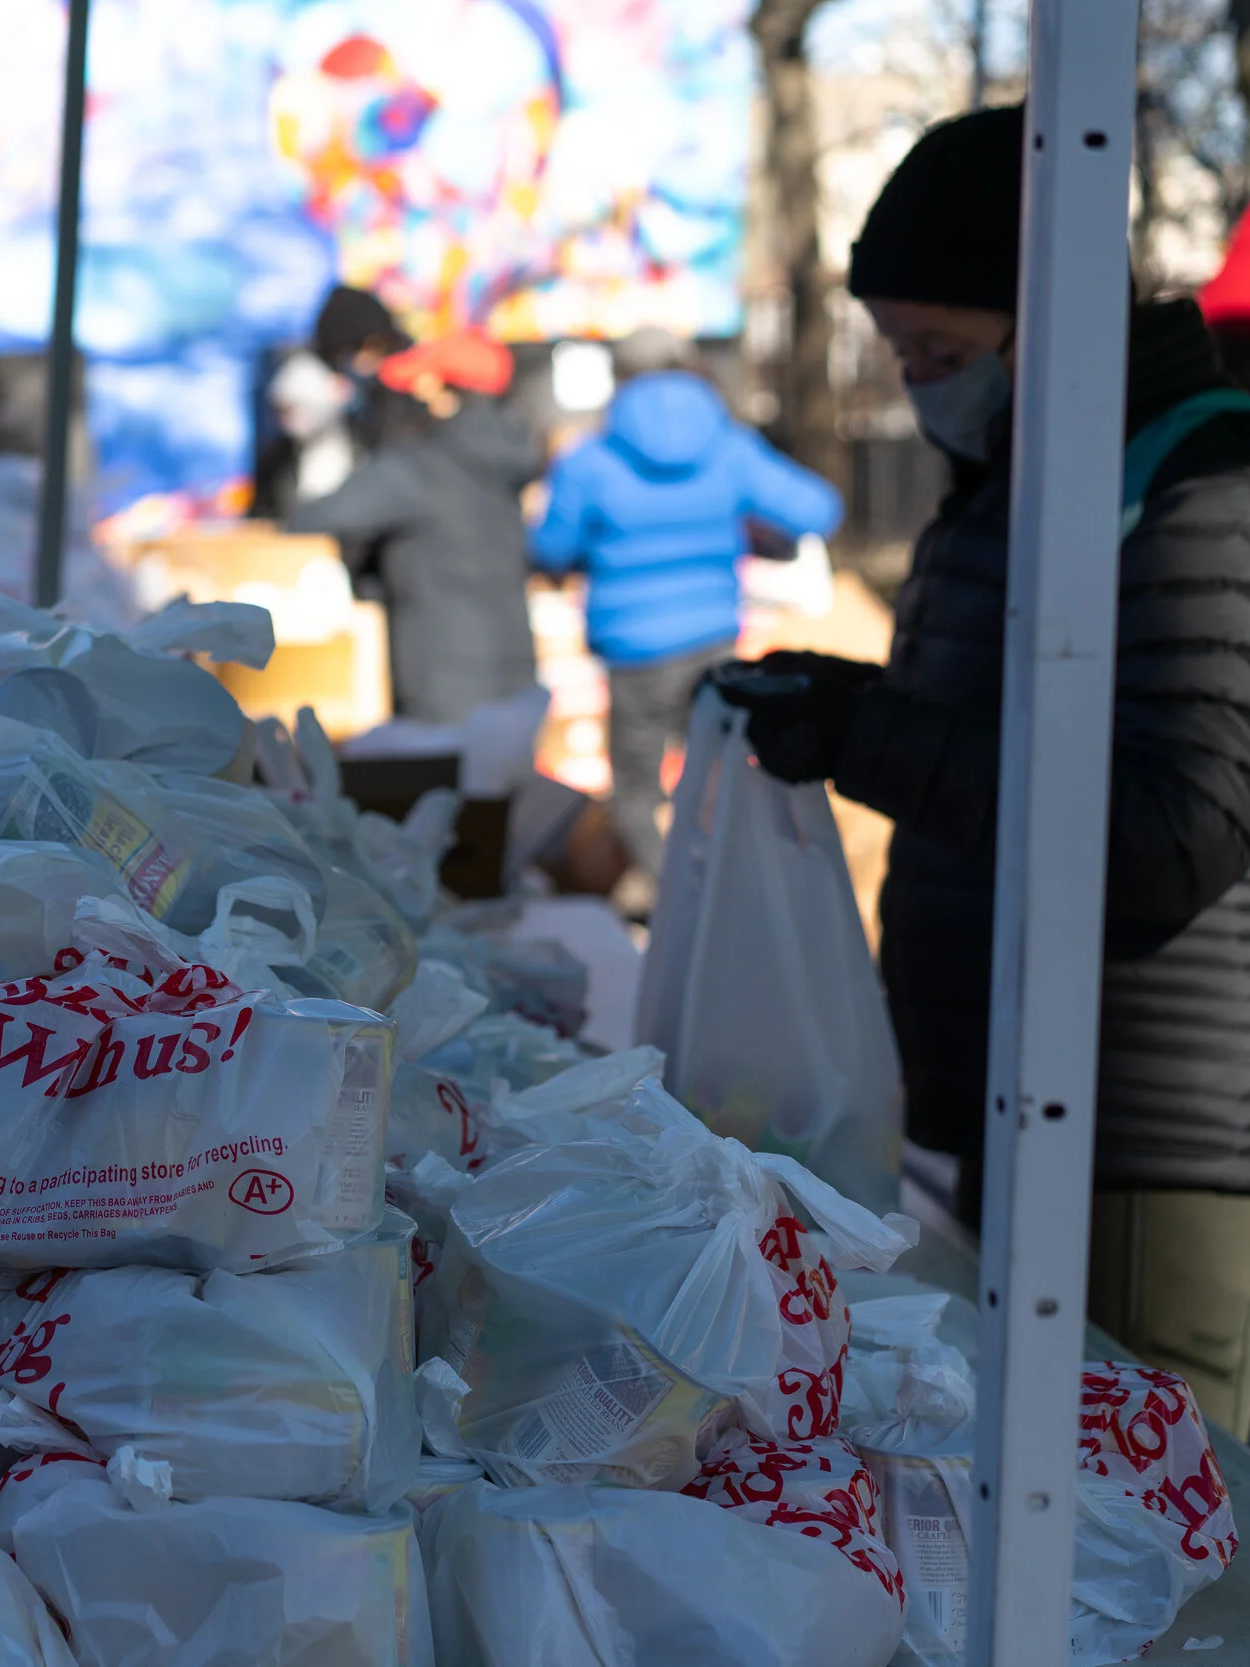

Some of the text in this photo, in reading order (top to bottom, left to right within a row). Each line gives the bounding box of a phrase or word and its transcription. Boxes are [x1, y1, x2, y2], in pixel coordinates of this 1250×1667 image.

[133, 1007, 253, 1080] us!
[10, 1176, 26, 1195] to
[28, 1180, 37, 1193] a
[40, 1164, 138, 1195] participating
[141, 1161, 185, 1181] store
[187, 1153, 203, 1173] for
[205, 1135, 288, 1164] recycling.
[0, 1208, 11, 1217] OF
[64, 1199, 86, 1208] KEEP
[88, 1198, 106, 1207] THIS
[108, 1197, 126, 1207] BAG
[149, 1194, 173, 1204] FROM
[197, 1180, 215, 1192] AND
[243, 1175, 282, 1204] A+
[72, 1209, 121, 1219] CARRIAGES
[11, 1231, 35, 1240] Reuse
[37, 1232, 46, 1240] or
[47, 1229, 80, 1241] Recycle
[81, 1228, 99, 1238] This
[100, 1228, 116, 1239] Bag
[592, 1385, 635, 1427] QUALITY
